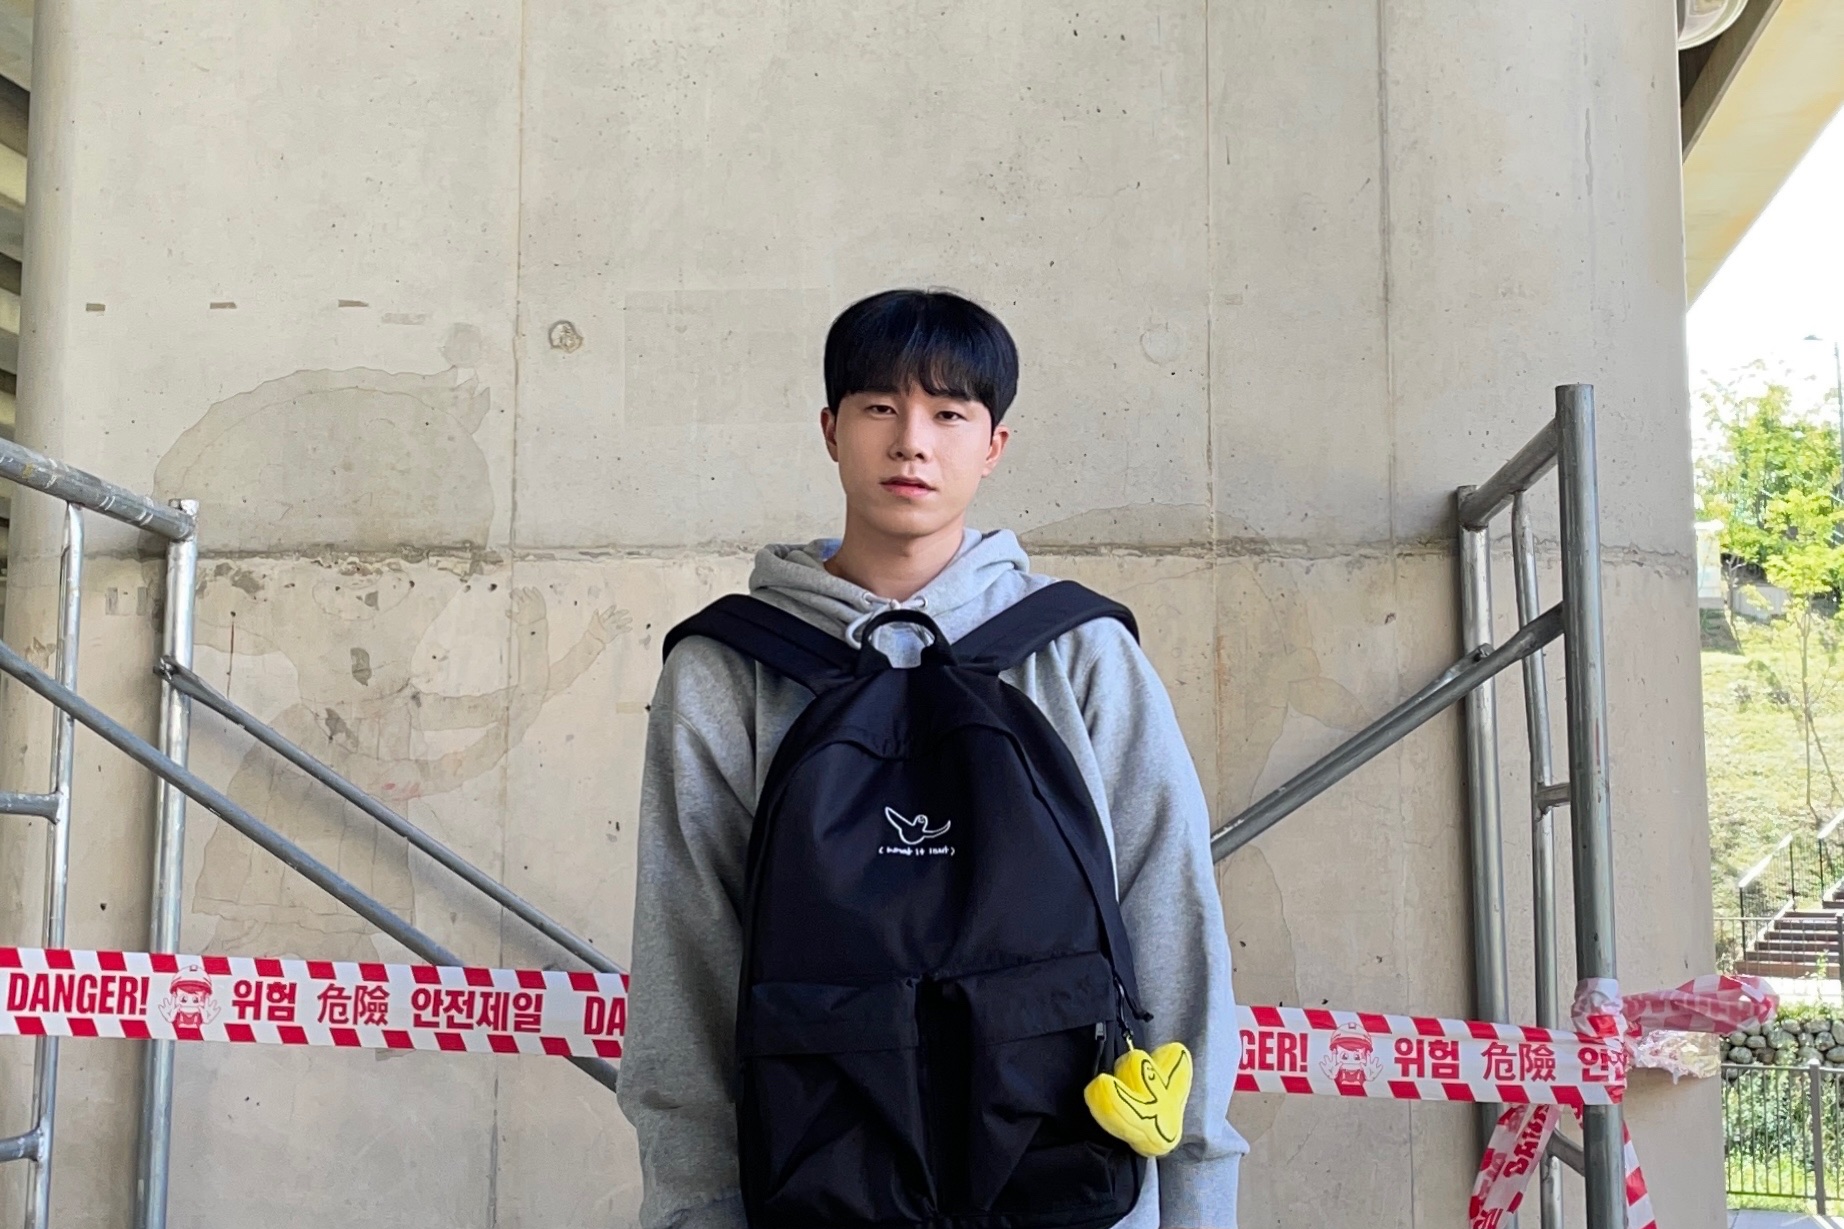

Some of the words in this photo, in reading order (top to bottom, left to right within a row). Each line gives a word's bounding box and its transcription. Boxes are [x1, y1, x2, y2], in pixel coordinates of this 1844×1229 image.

[7, 973, 150, 1015] DANGER!
[232, 980, 297, 1022] 위험
[317, 983, 390, 1026] 危險
[411, 988, 543, 1033] 안전제일
[1394, 1038, 1460, 1079] 위험
[1481, 1042, 1556, 1082] 危險
